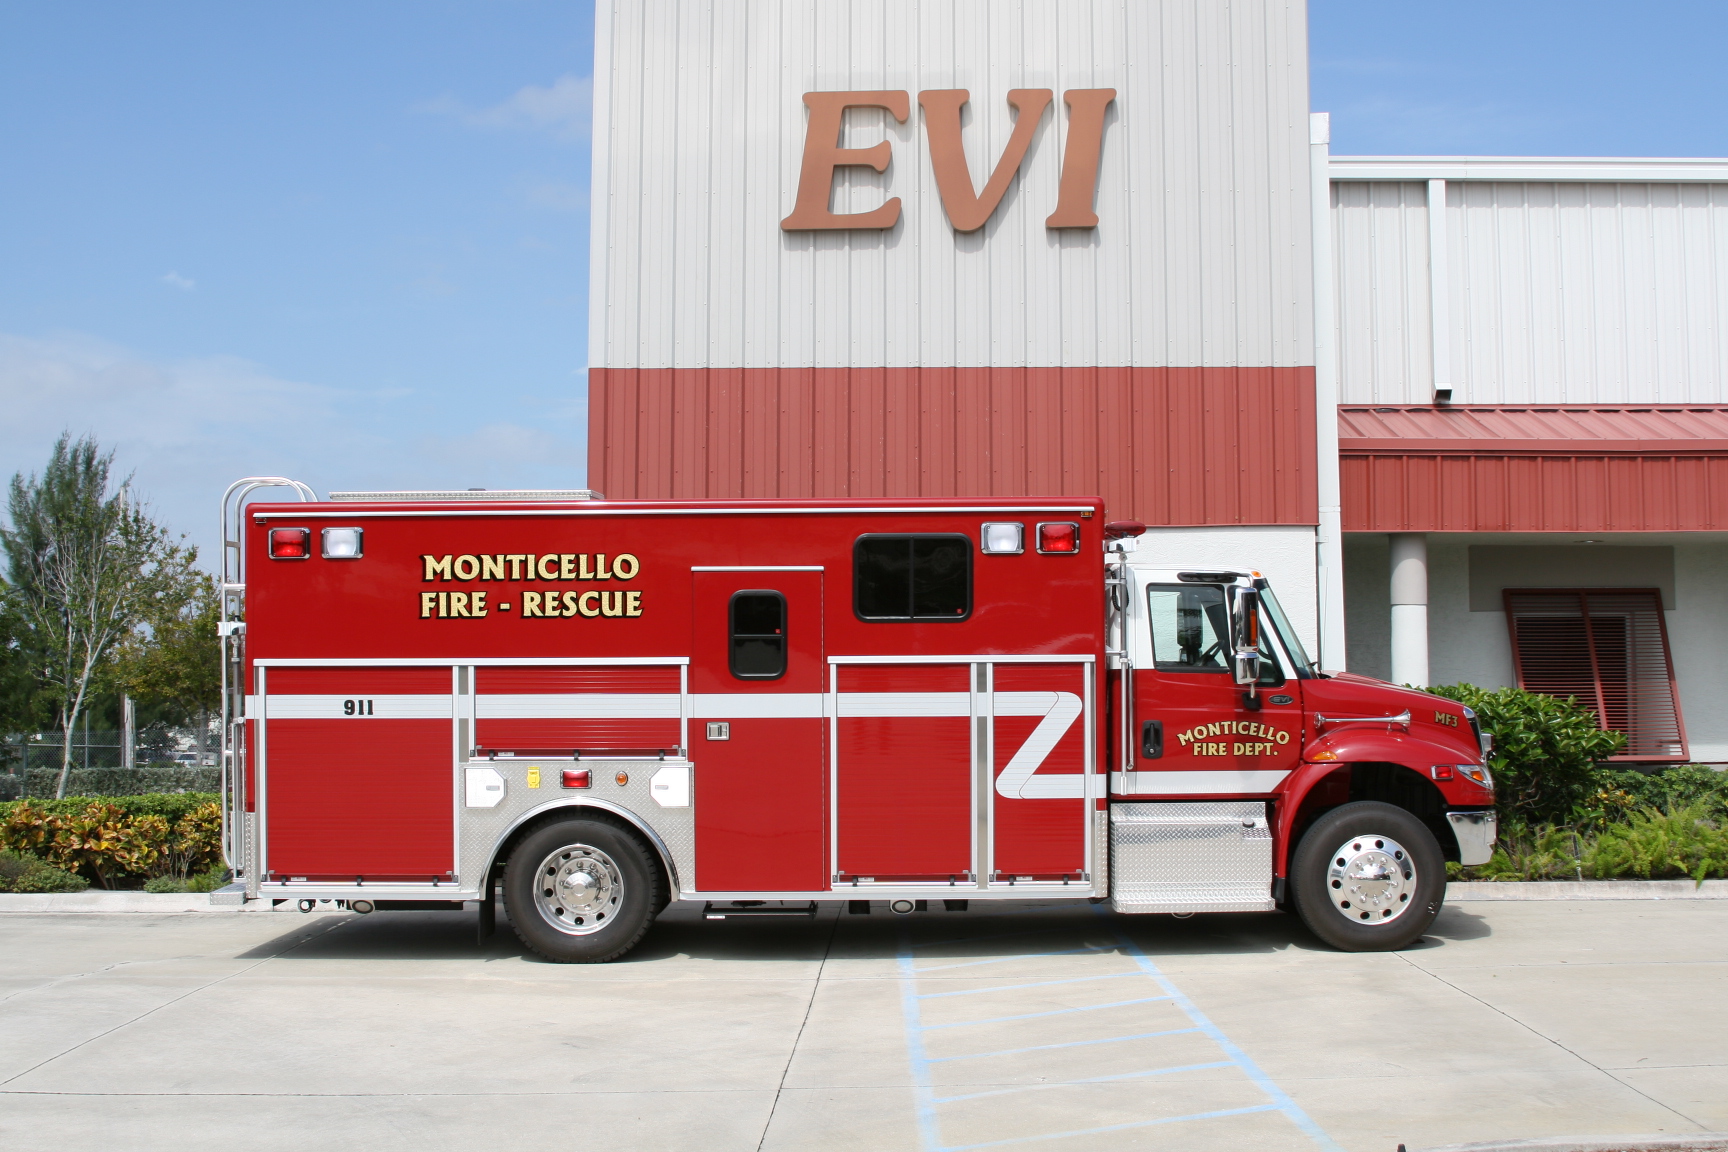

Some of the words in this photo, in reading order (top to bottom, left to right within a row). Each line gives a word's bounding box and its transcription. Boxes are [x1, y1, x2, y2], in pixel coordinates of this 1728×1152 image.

[780, 88, 1117, 232] EVI
[420, 553, 641, 582] MONTICELLO
[419, 591, 489, 619] FIRE
[521, 590, 644, 619] RESCUE
[343, 699, 374, 716] 911
[1434, 710, 1459, 728] MF3
[1176, 720, 1290, 747] MONTICELLO
[1193, 742, 1228, 756] FIRE
[1233, 742, 1279, 756] DEPT.
